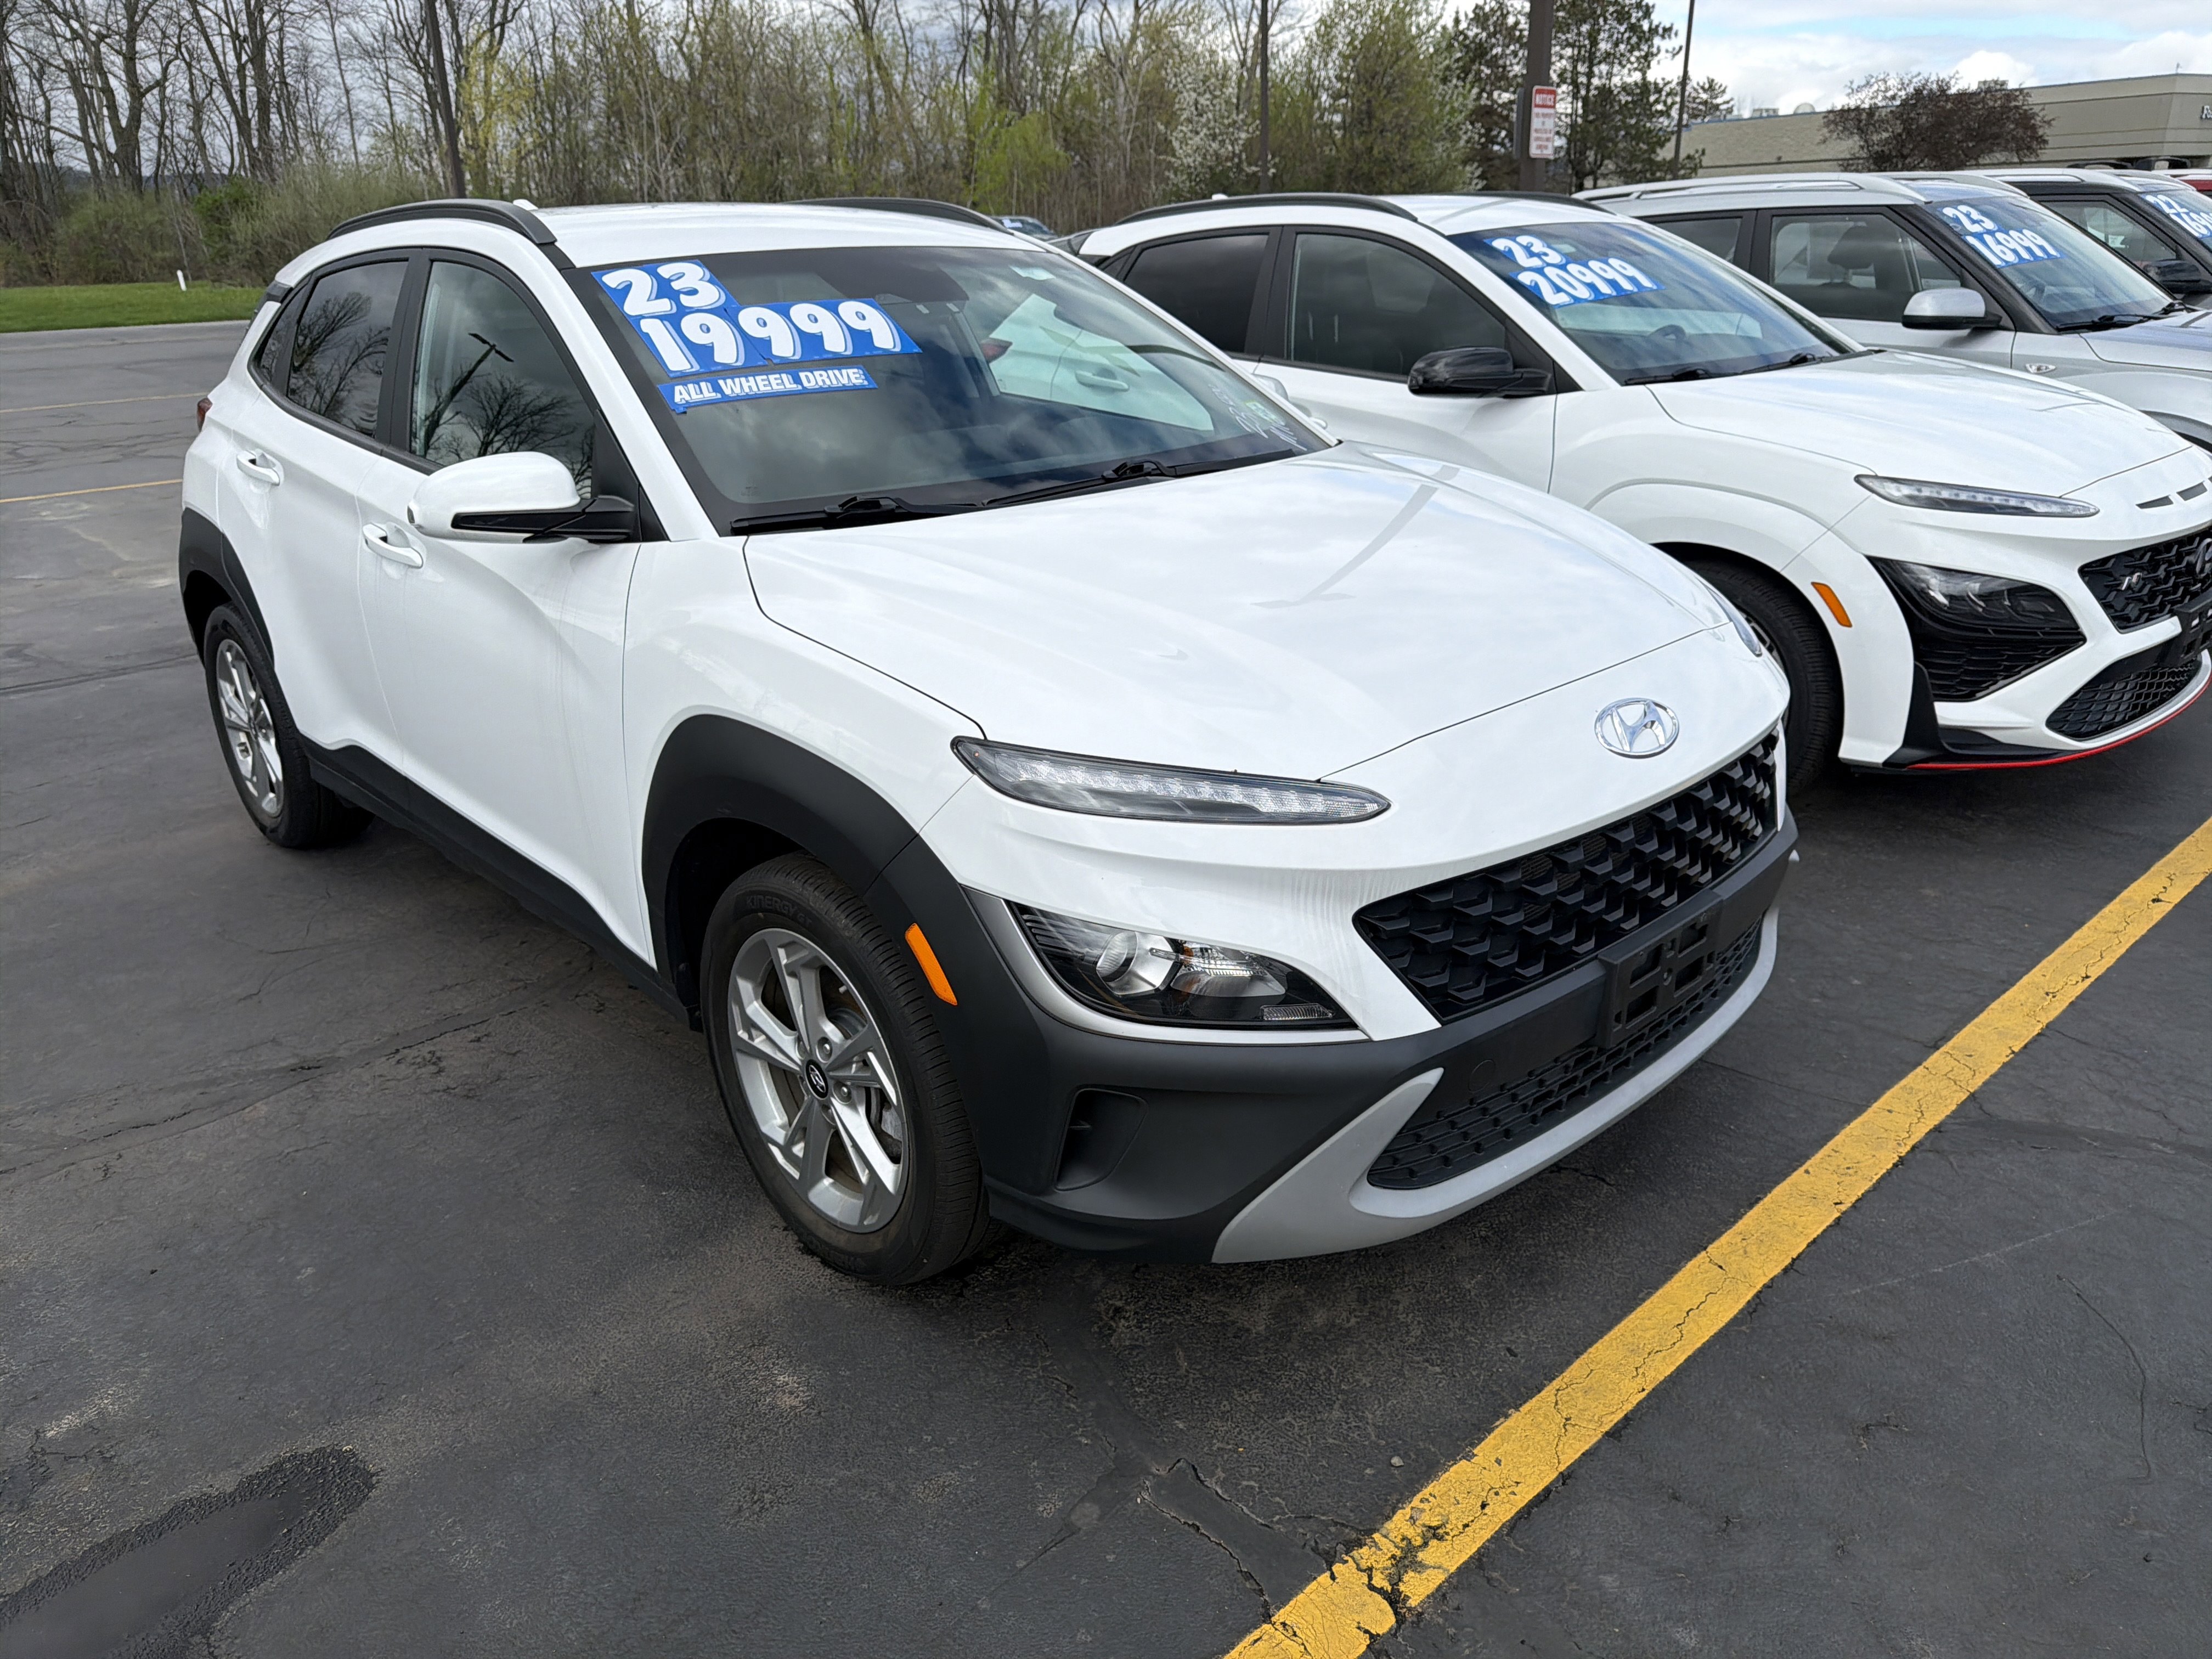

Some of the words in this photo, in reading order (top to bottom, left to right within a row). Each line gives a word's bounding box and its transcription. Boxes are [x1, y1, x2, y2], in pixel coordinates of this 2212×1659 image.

[1943, 205, 1998, 233] 23
[2146, 194, 2190, 213] 22
[1492, 235, 1566, 268] 23
[1966, 229, 2060, 266] 16999
[601, 262, 726, 317] 23
[1517, 257, 1657, 305] 20999
[640, 301, 901, 373] 19999
[674, 381, 721, 404] ALL
[718, 373, 803, 396] WHEEL
[798, 368, 868, 388] DRIVE
[746, 895, 798, 918] KINERGY
